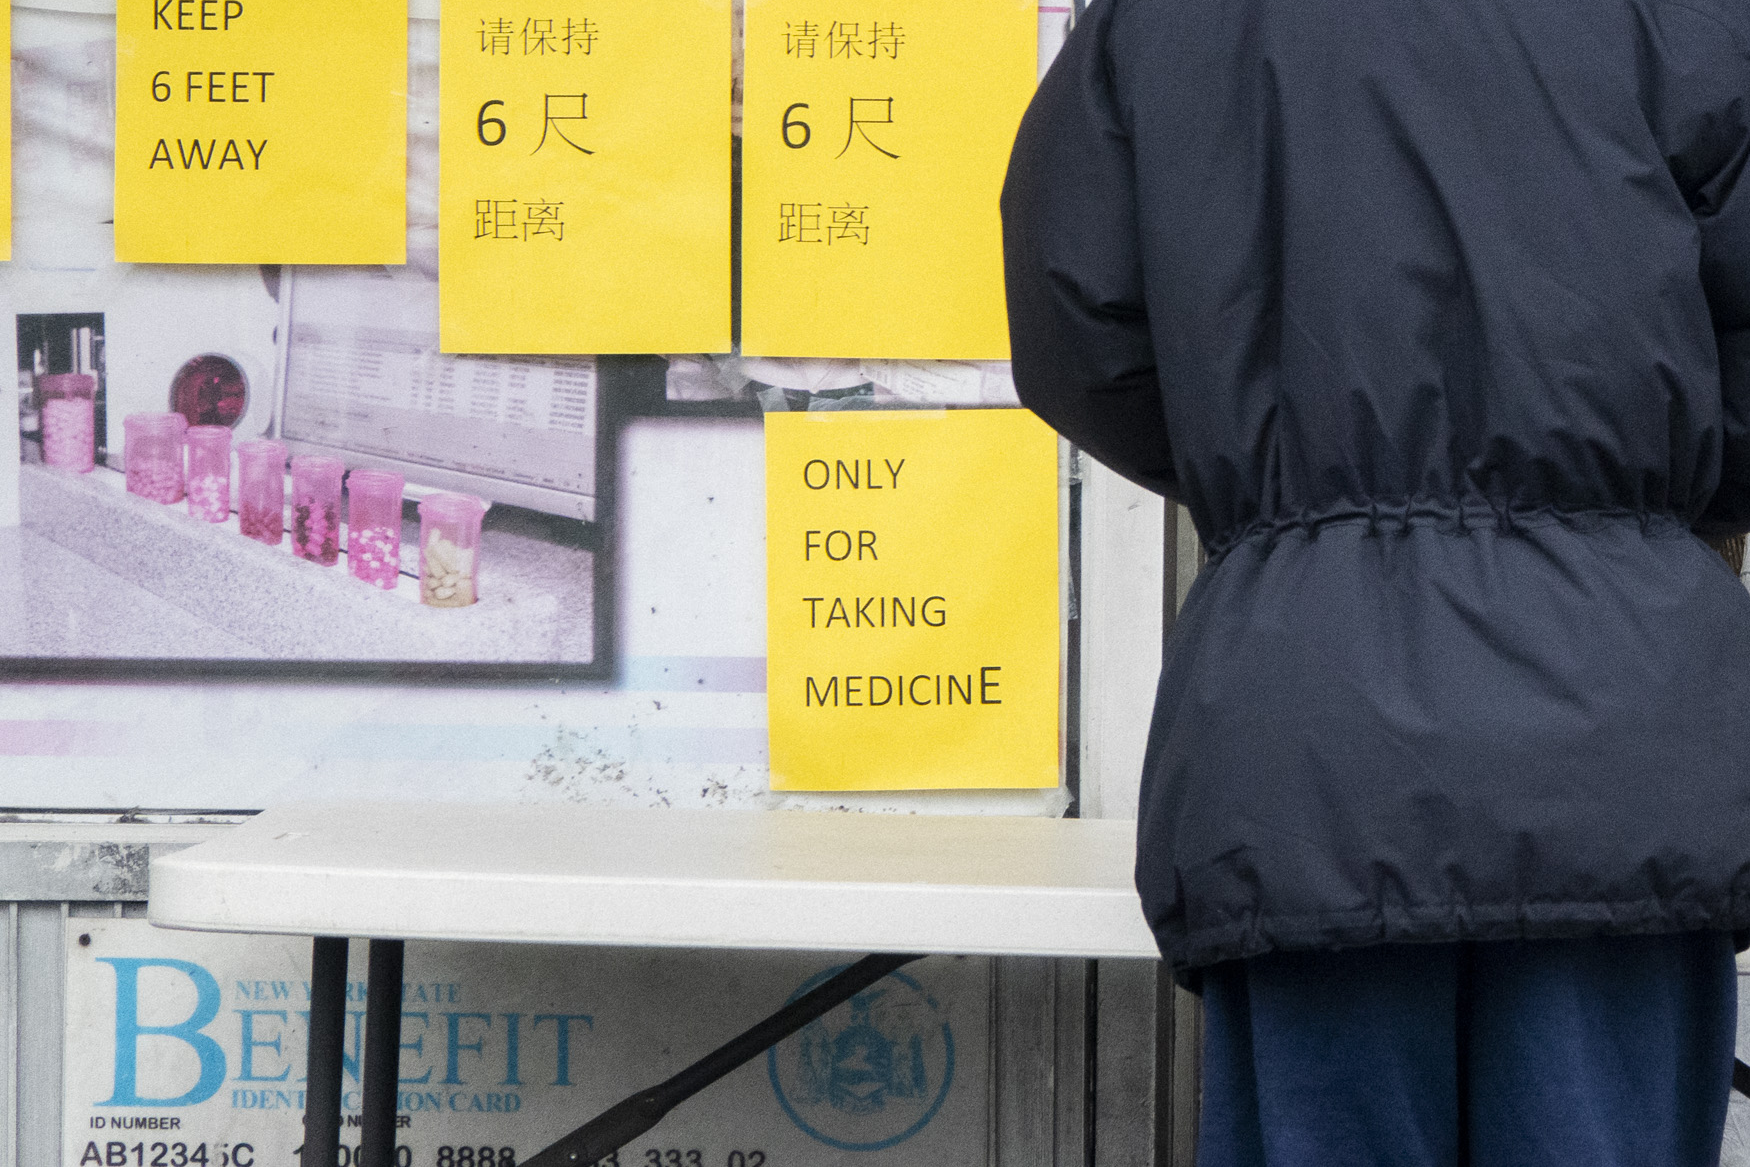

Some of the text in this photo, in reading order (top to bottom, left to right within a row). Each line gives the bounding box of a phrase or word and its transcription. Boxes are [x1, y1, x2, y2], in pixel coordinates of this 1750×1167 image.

[153, 0, 244, 31] KEEP
[475, 16, 599, 57] 请保持
[780, 20, 906, 60] 请保持
[151, 71, 275, 103] 6 FEET
[476, 91, 596, 156] 6 尺
[781, 95, 901, 160] 6 尺
[149, 138, 268, 171] AWAY
[473, 197, 565, 242] 距离
[778, 200, 870, 246] 距离
[803, 458, 906, 490] ONLY
[805, 530, 879, 562] FOR
[802, 596, 947, 629] TAKING
[805, 666, 1002, 708] MEDICINE
[235, 980, 292, 1001] NEW
[449, 1092, 521, 1113] CARD
[90, 1116, 181, 1130] ID NUMBER
